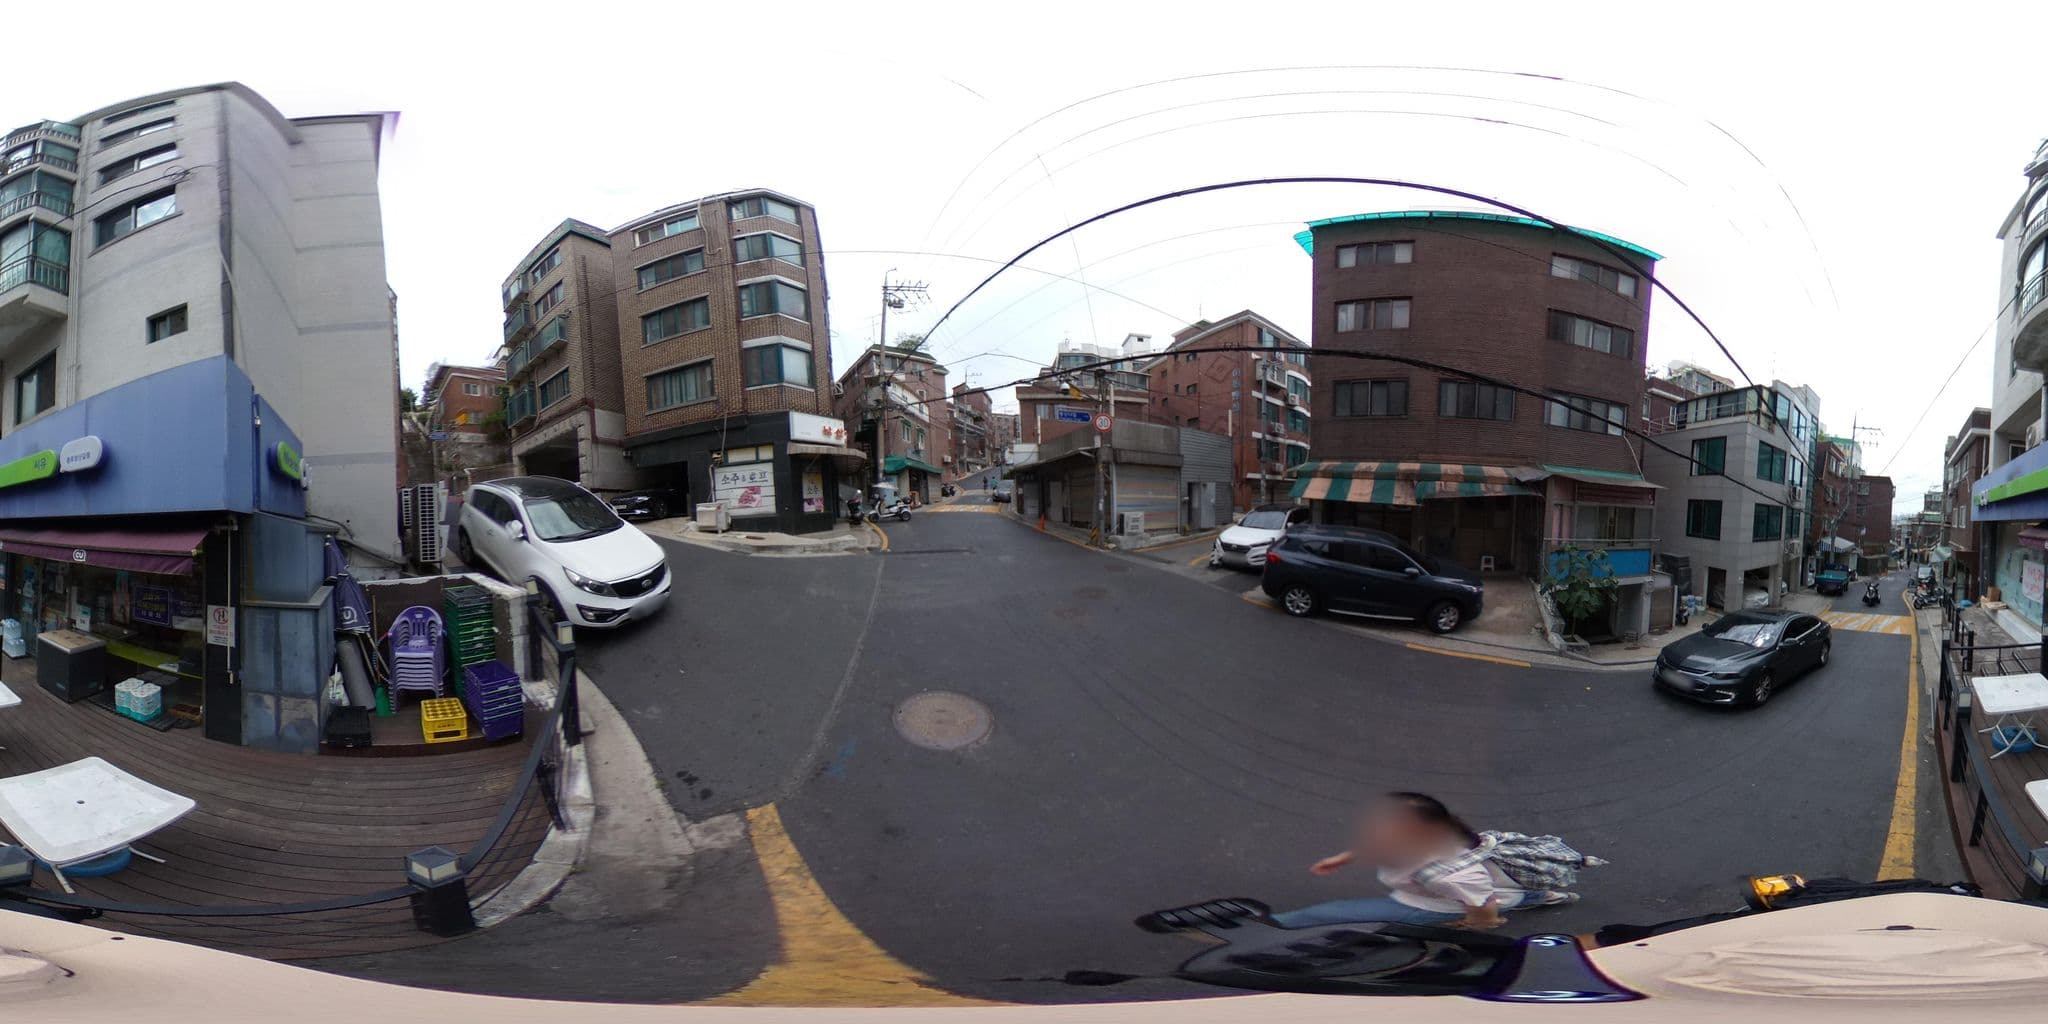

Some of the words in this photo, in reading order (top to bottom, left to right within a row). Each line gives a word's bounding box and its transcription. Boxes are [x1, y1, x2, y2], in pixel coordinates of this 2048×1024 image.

[1099, 417, 1109, 427] 30
[721, 473, 740, 485] 소주
[748, 471, 769, 483] 호프
